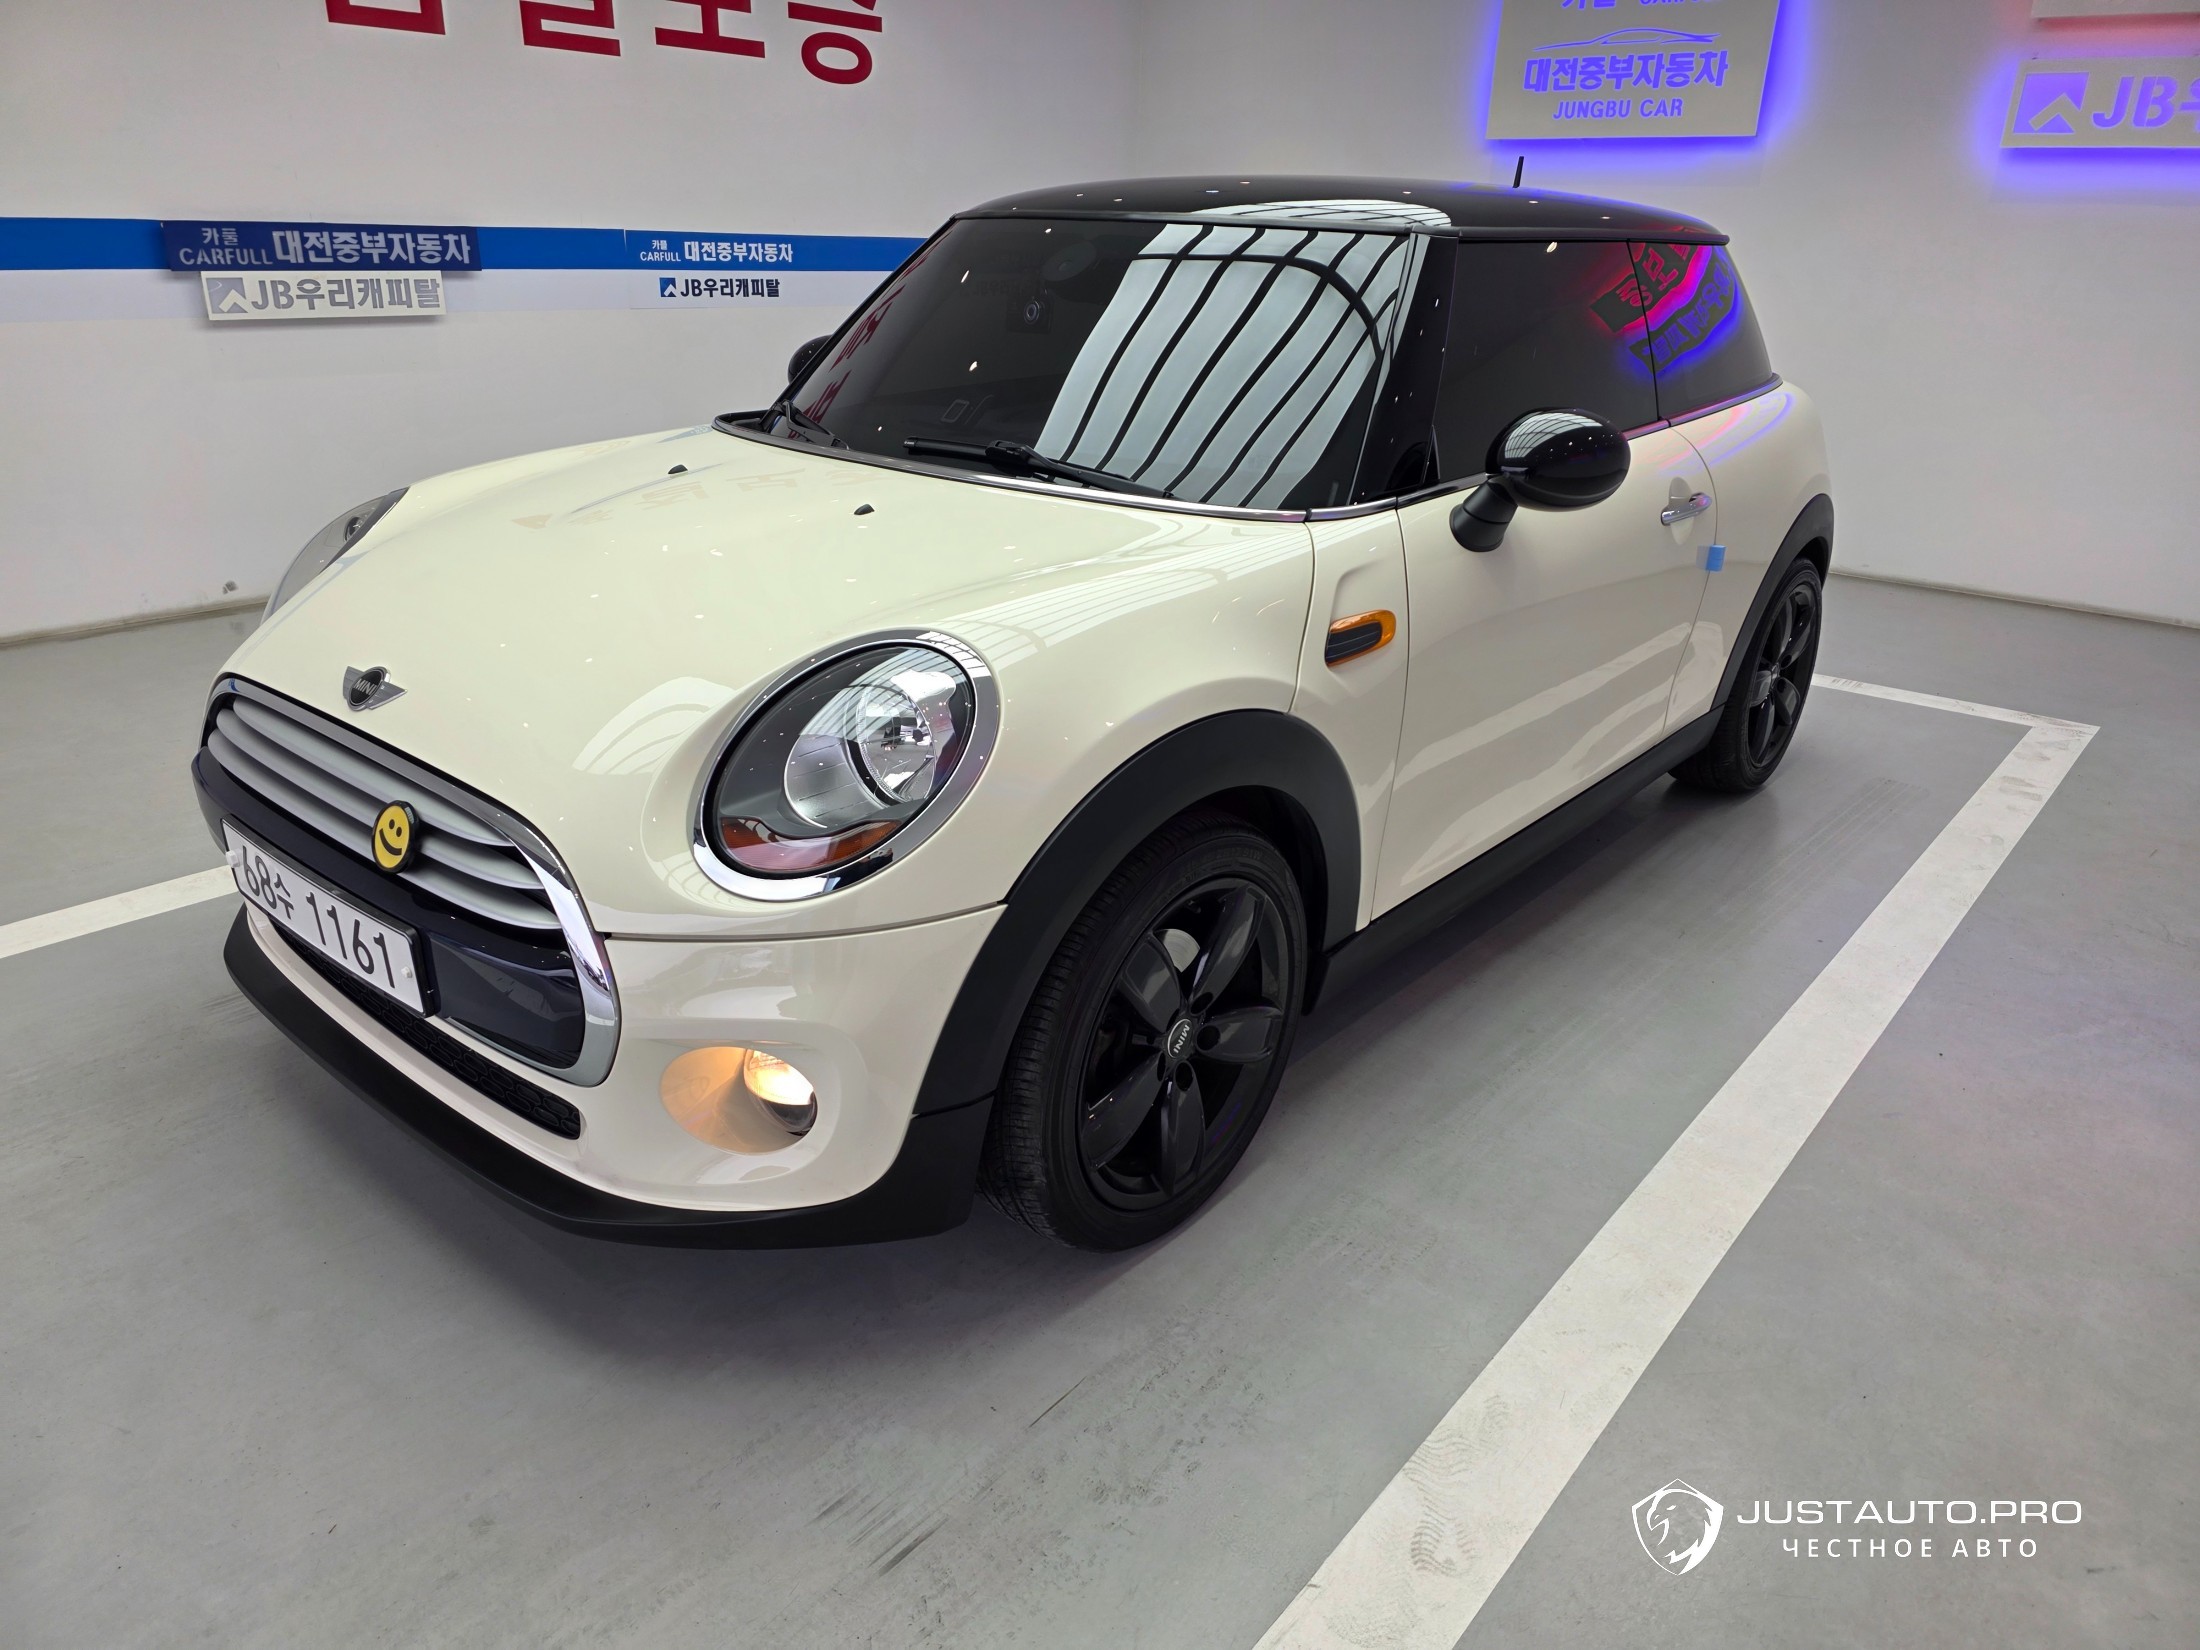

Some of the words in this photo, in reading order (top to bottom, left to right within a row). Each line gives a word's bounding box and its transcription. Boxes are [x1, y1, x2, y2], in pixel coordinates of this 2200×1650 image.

[1523, 50, 1729, 93] 대전중부자동차
[1552, 100, 1631, 120] JUNGBU
[1639, 98, 1683, 118] CAR
[179, 248, 273, 265] CARFULL
[272, 230, 471, 264] 대전중부자동차
[640, 251, 681, 262] CARFULL
[684, 241, 793, 262] 대전중부자동차
[251, 278, 440, 310] JB우리캐피탈
[680, 278, 780, 297] JB우리캐피탈
[354, 678, 378, 695] MINI
[242, 845, 295, 919] 68수
[306, 891, 395, 989] 1161
[1173, 1024, 1190, 1054] MINI
